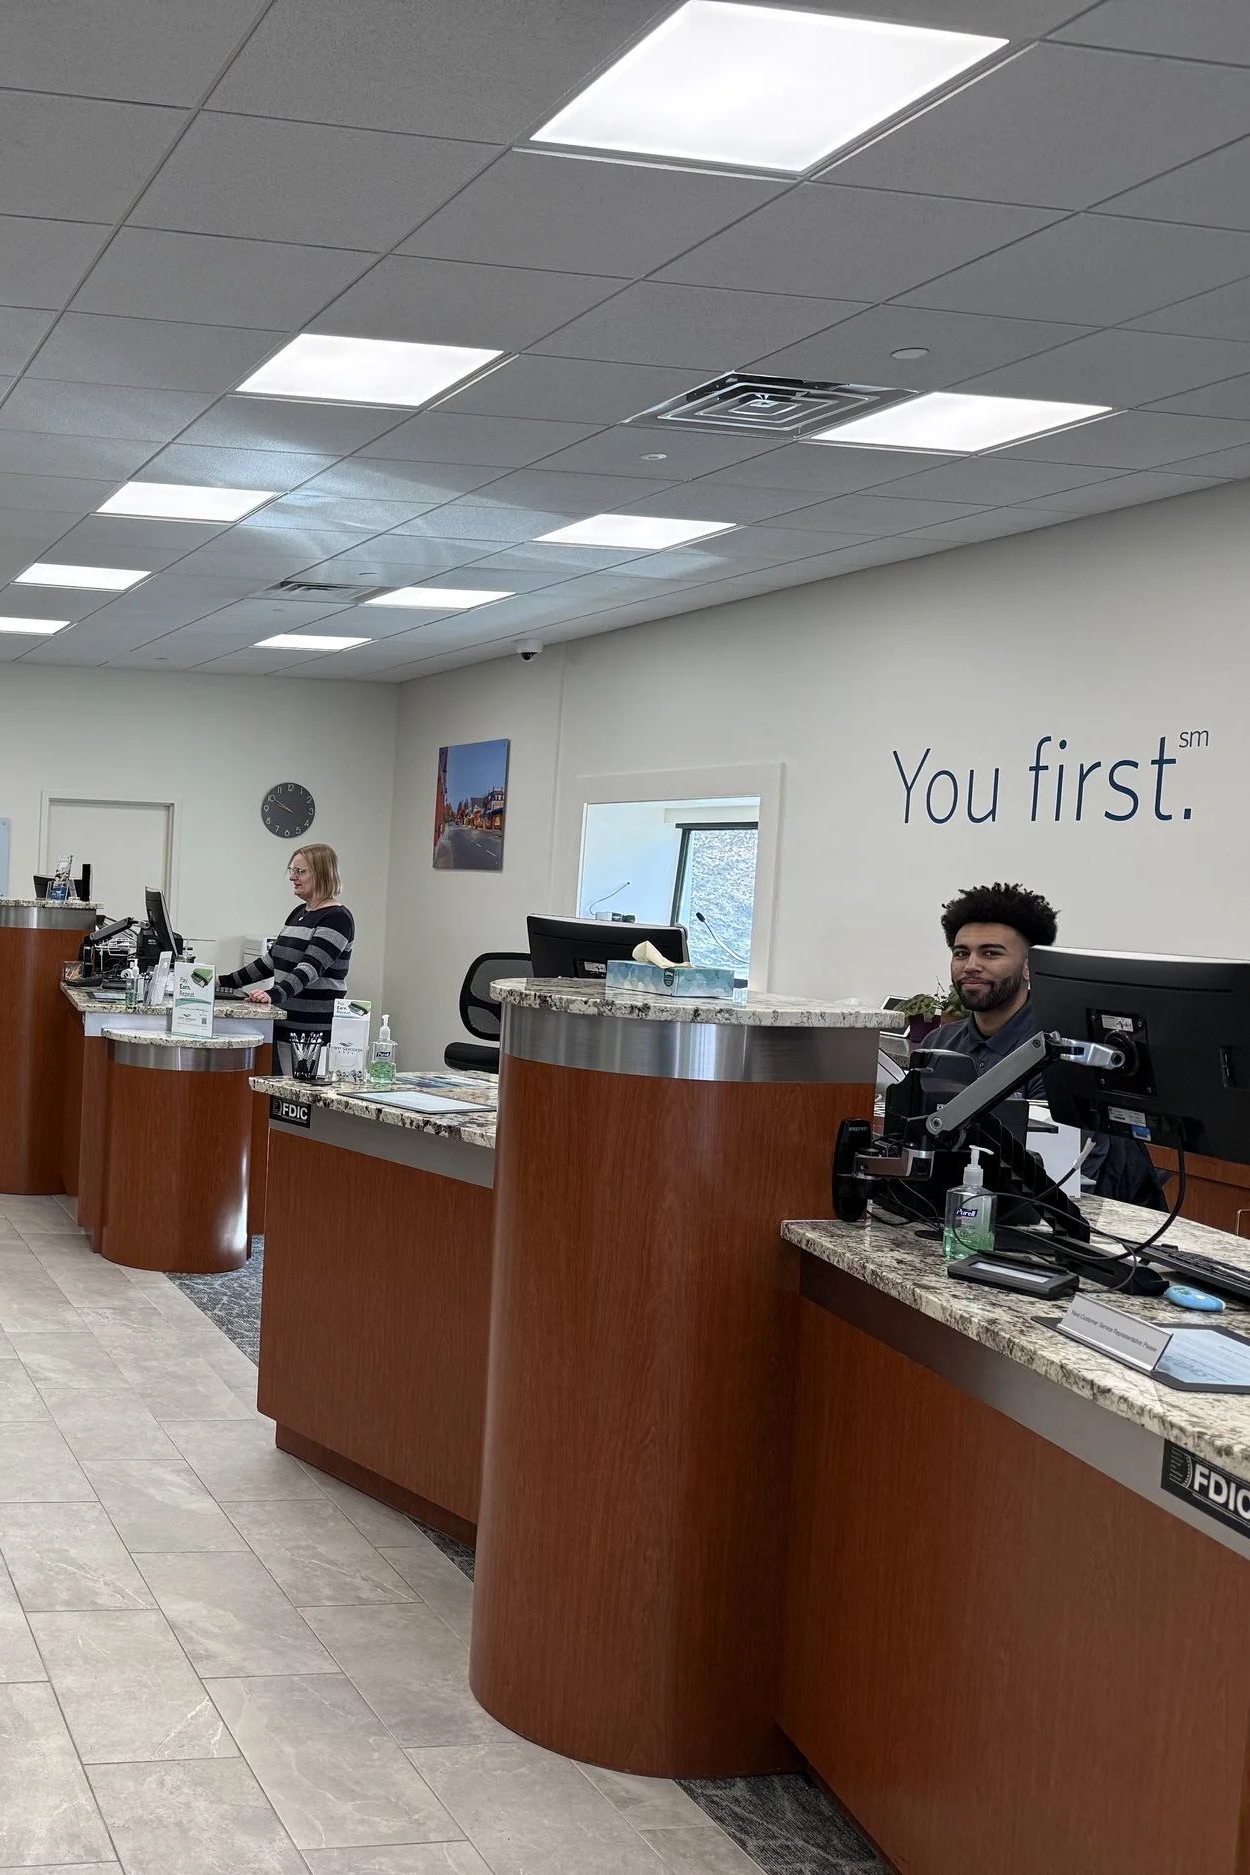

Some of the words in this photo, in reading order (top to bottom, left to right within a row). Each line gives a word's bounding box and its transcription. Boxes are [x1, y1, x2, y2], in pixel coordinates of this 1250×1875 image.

[892, 748, 1000, 824] You
[1028, 735, 1193, 822] first.
[1178, 729, 1210, 748] sm
[277, 786, 283, 794] 11
[287, 784, 294, 792] 12
[267, 794, 276, 803] 10
[306, 796, 312, 804] 2
[308, 807, 314, 815] 3
[303, 819, 309, 827] 4
[274, 825, 280, 833] 7
[295, 826, 301, 834] 5
[282, 1102, 308, 1120] FDIC
[1193, 1463, 1250, 1520] FDIC
